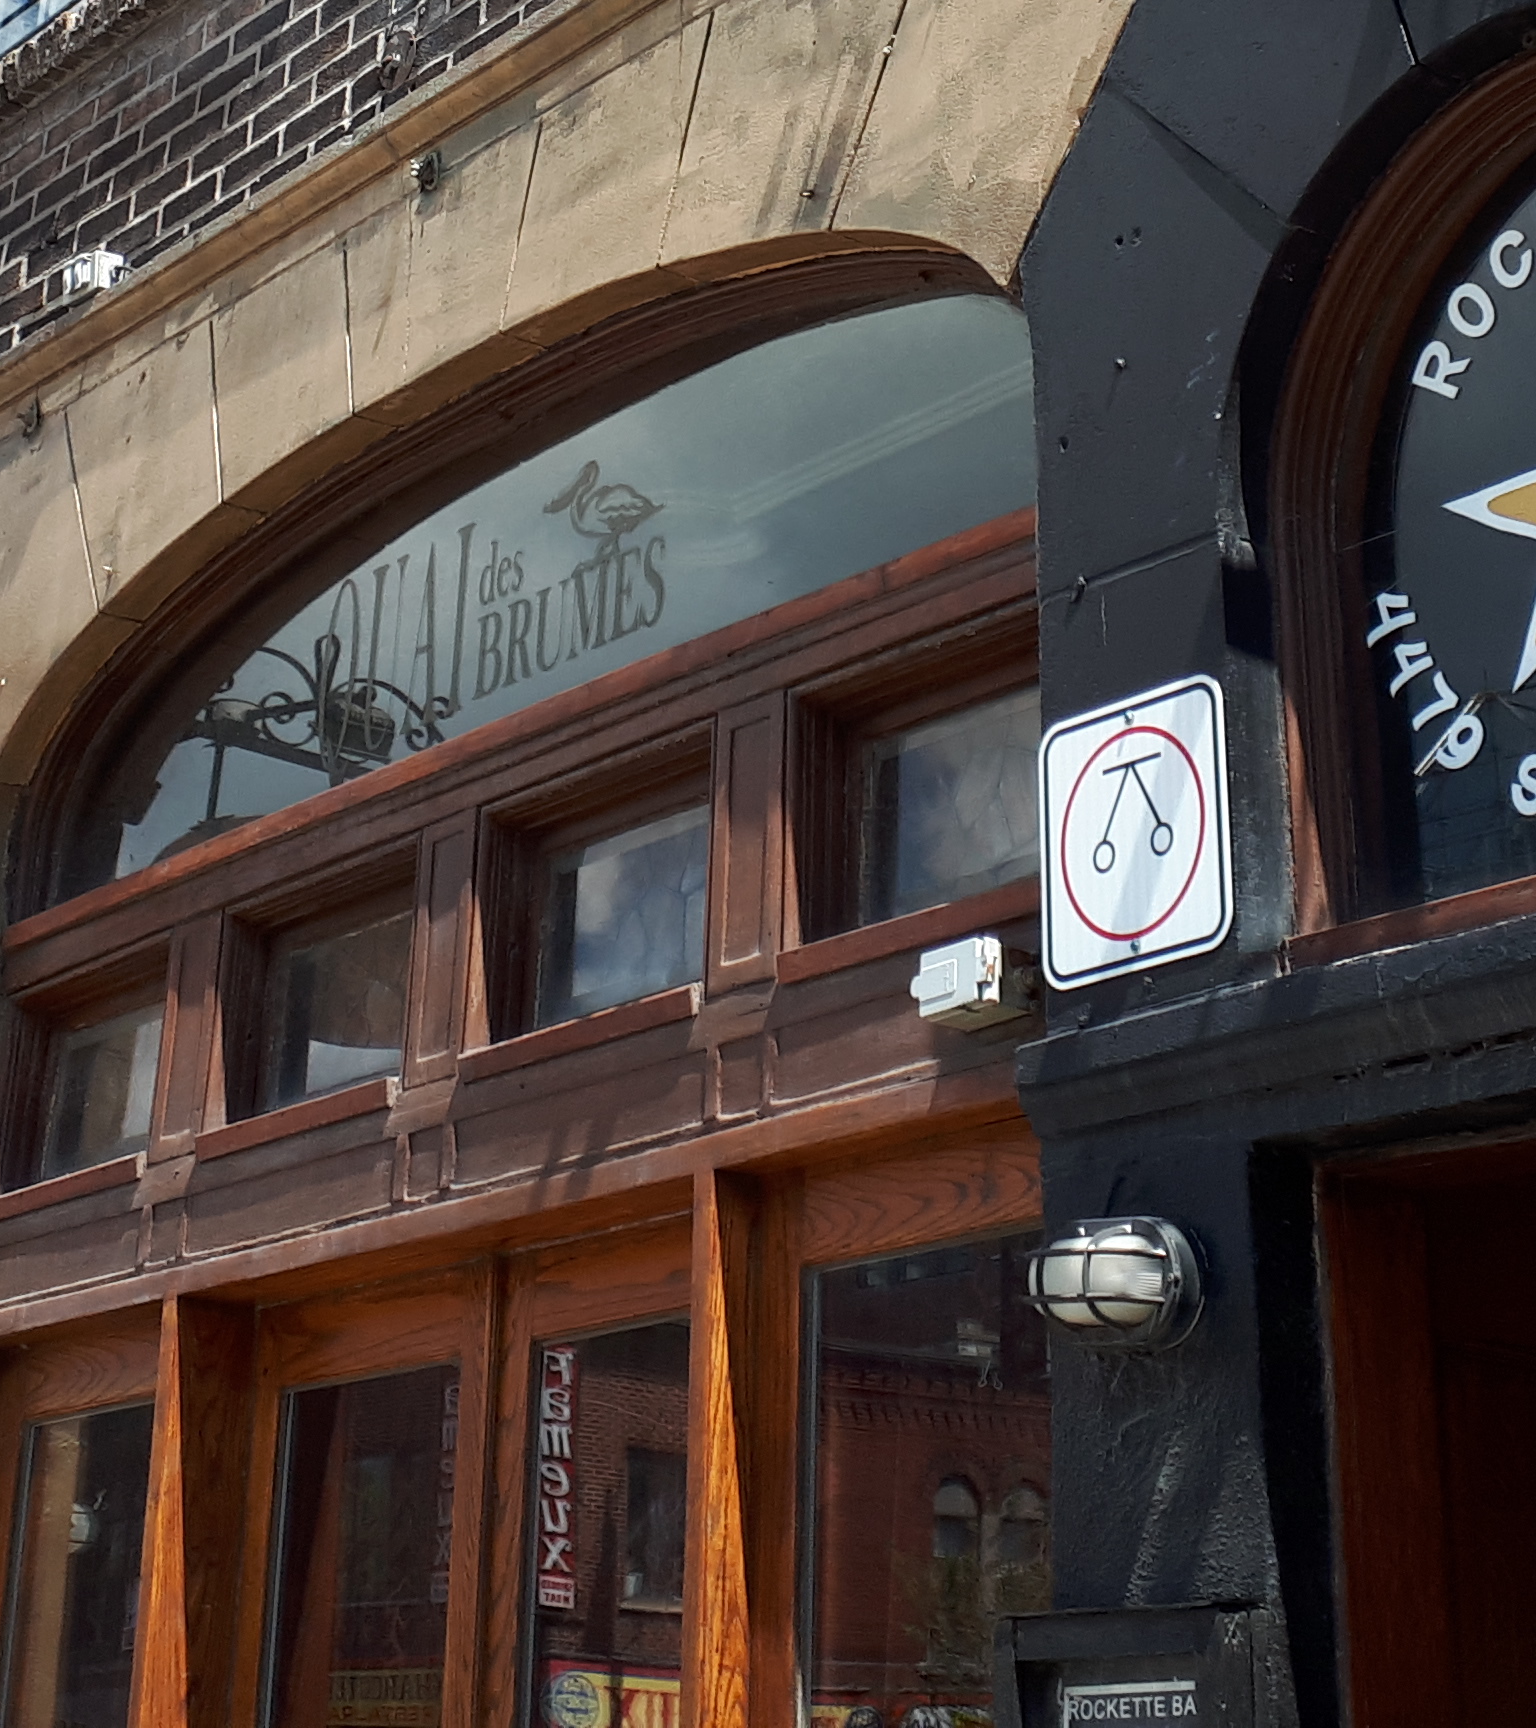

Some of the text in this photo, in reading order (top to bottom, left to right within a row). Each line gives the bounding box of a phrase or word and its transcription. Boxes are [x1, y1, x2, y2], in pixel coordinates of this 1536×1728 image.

[313, 522, 477, 773] QUAI
[472, 535, 666, 702] BRUMES
[478, 540, 525, 606] des
[1365, 591, 1485, 771] 4479
[1068, 1694, 1166, 1722] ROCKETTE
